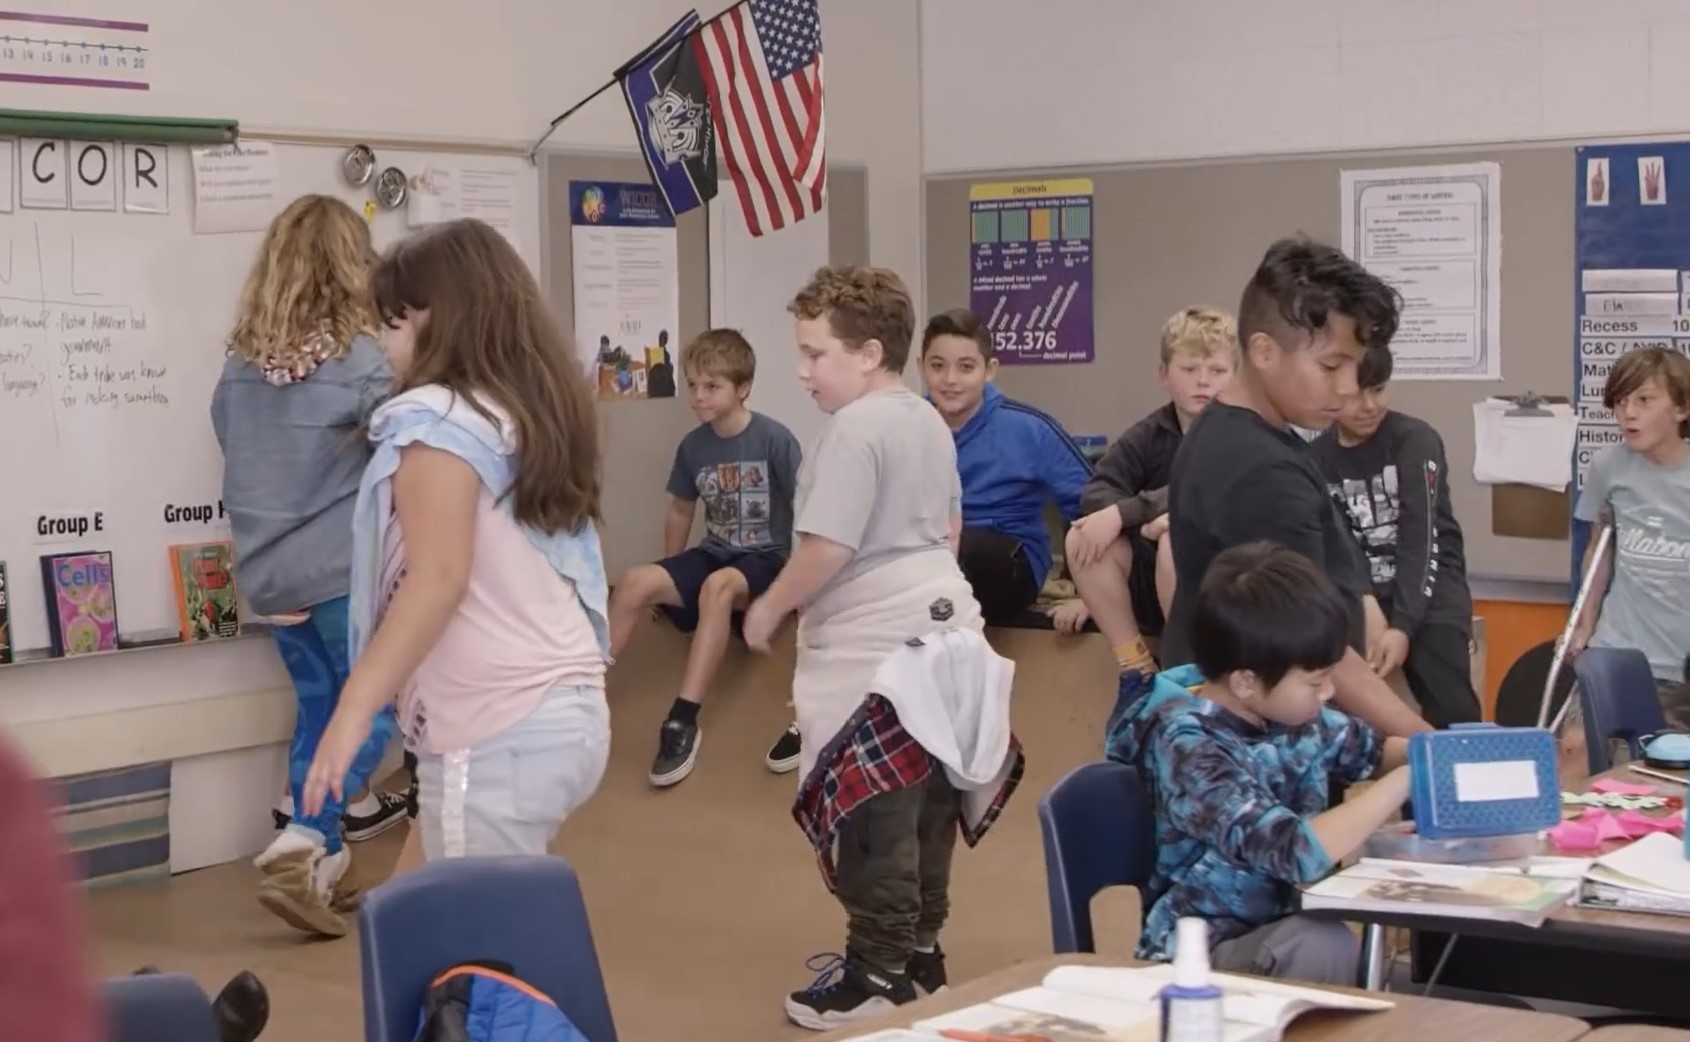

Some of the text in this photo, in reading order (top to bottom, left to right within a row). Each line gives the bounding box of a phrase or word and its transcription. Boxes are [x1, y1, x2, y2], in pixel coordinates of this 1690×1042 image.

[3, 48, 146, 70] 13 14 15 16 17 18 19 20
[1013, 185, 1047, 195] Decimals
[1582, 320, 1638, 333] Recess
[1582, 342, 1616, 355] C&C
[1584, 364, 1616, 377] Mat
[164, 504, 213, 524] Group
[37, 512, 103, 537] Group E
[57, 564, 110, 588] Cells
